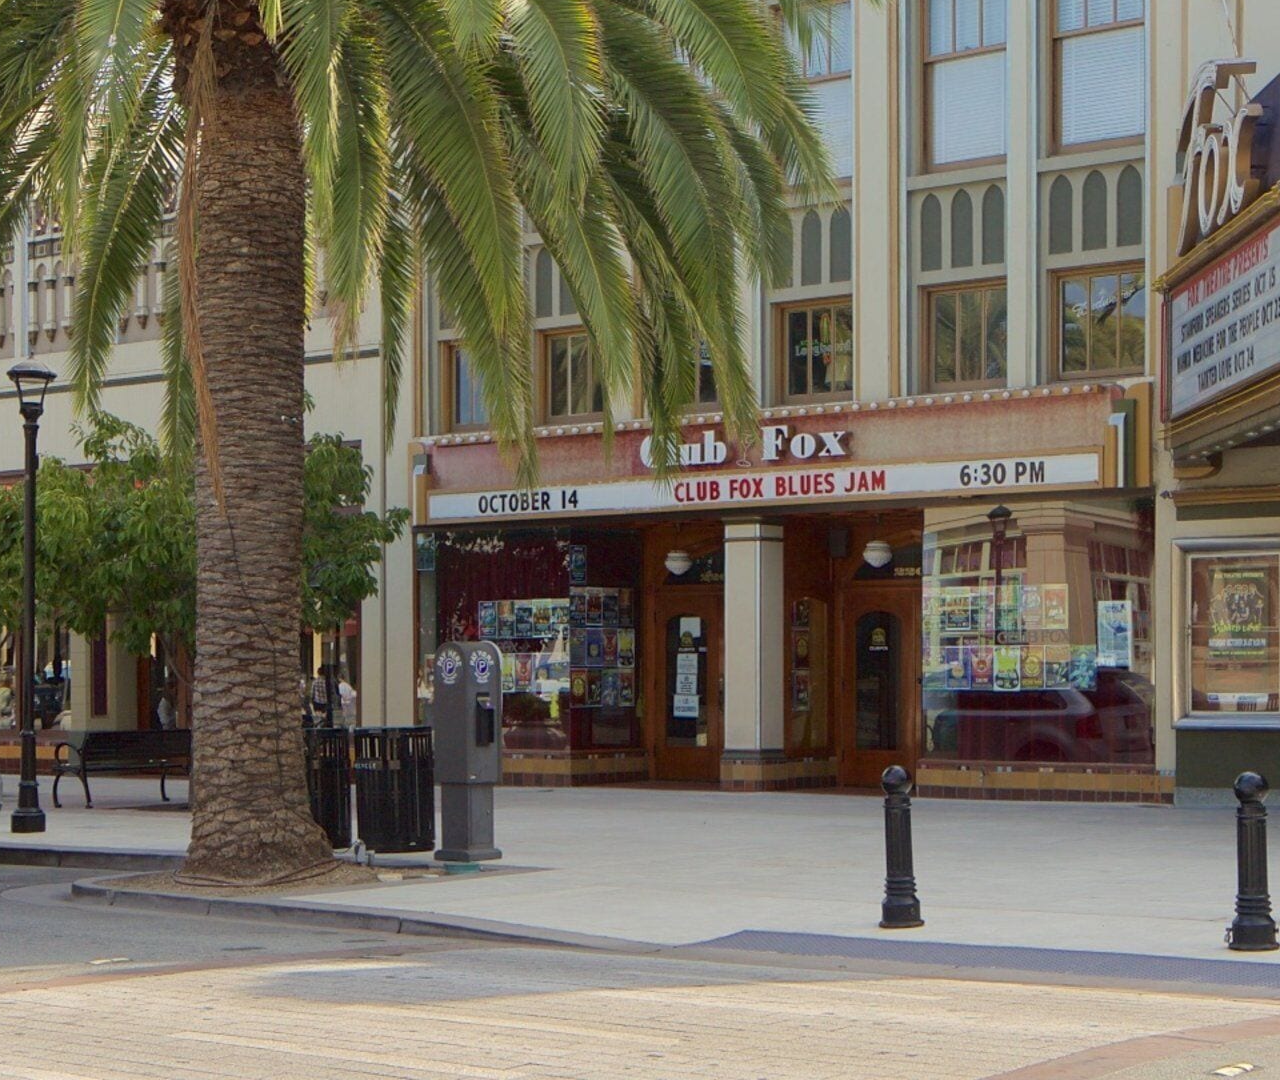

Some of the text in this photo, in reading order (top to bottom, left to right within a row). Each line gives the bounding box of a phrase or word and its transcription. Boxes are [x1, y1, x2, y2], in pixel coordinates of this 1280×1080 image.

[1176, 58, 1263, 255] Fox
[761, 425, 846, 461] Fox
[478, 460, 1045, 515] OCTOBER 14 CLUB FOX BLUES JAM 6:30 PM
